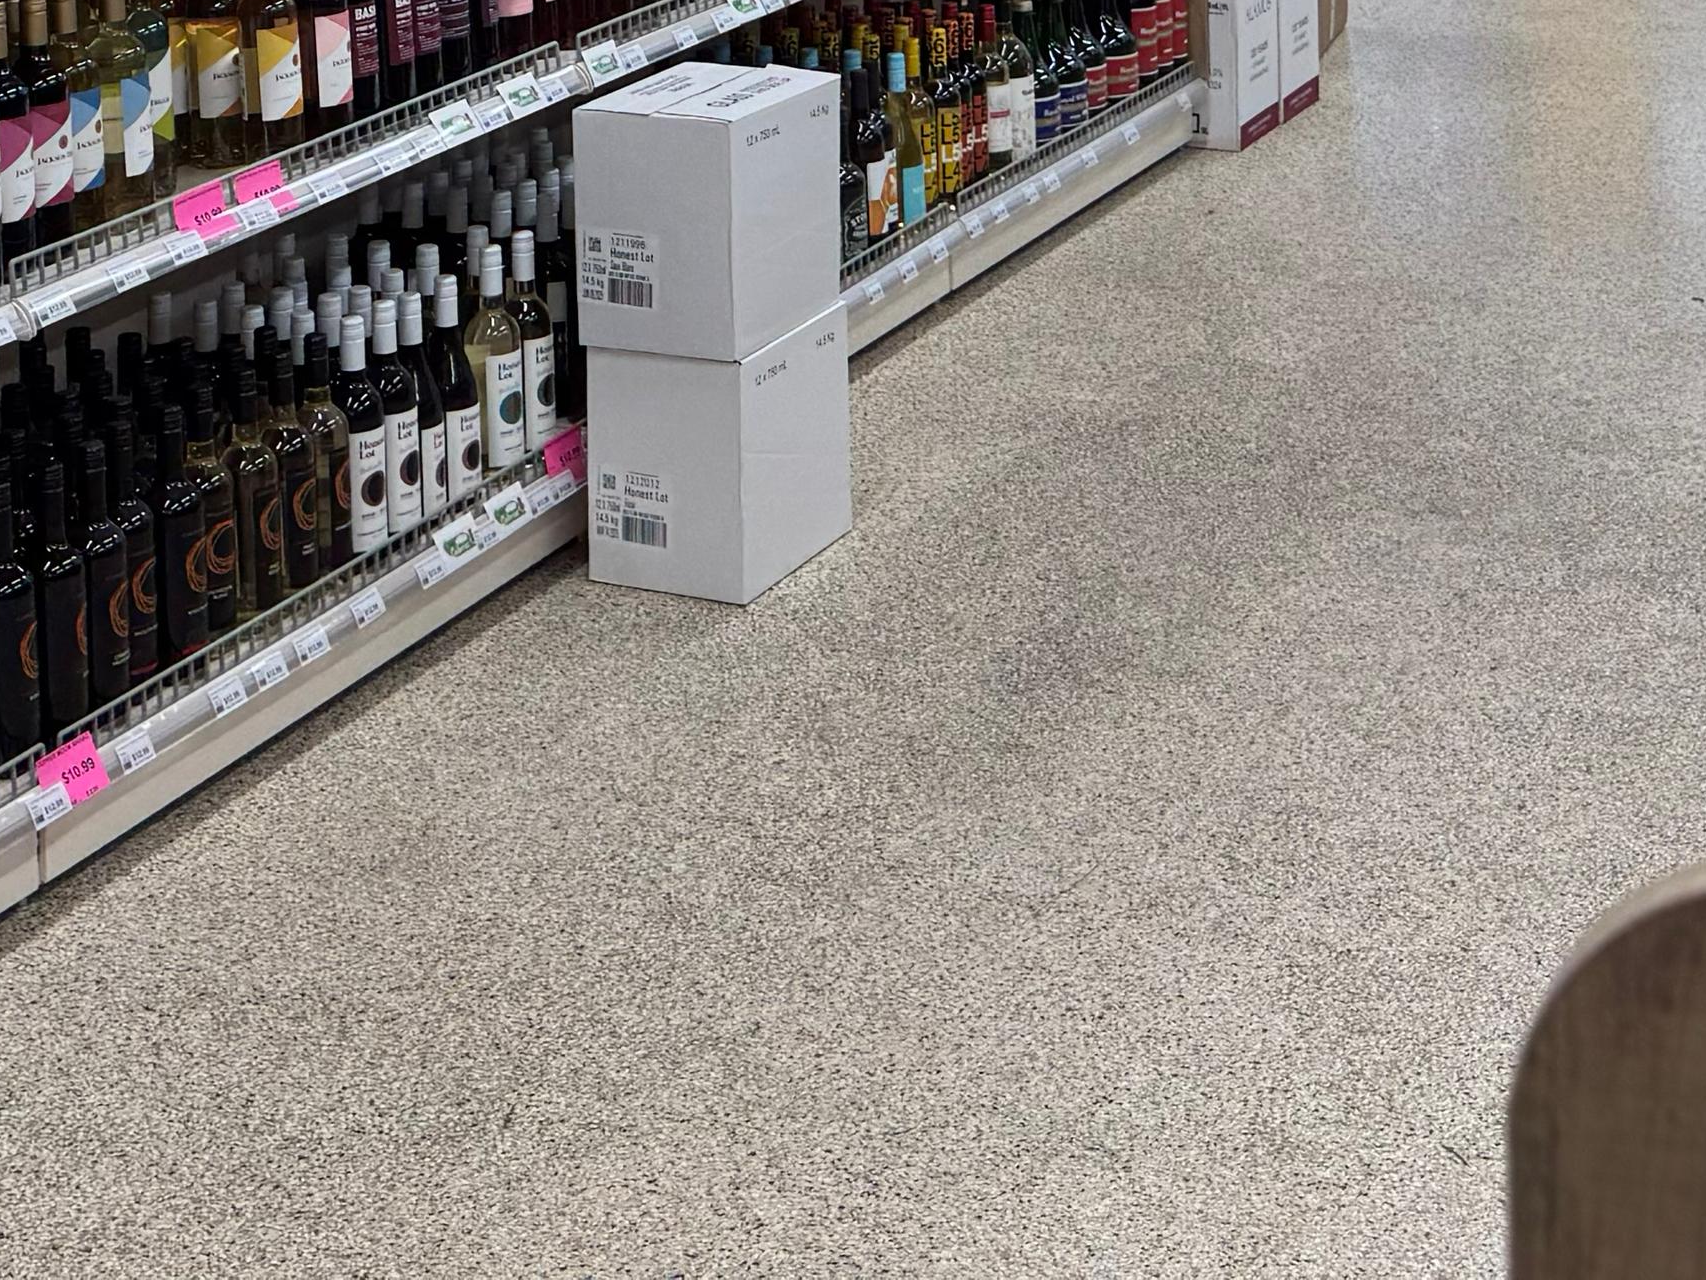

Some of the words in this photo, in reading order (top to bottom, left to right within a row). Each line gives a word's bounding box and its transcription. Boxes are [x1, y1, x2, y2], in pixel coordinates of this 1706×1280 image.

[610, 248, 638, 261] Honest
[640, 252, 654, 263] Lot
[624, 486, 651, 501] Honest
[653, 490, 668, 503] Lot
[62, 757, 95, 784] $10.99
